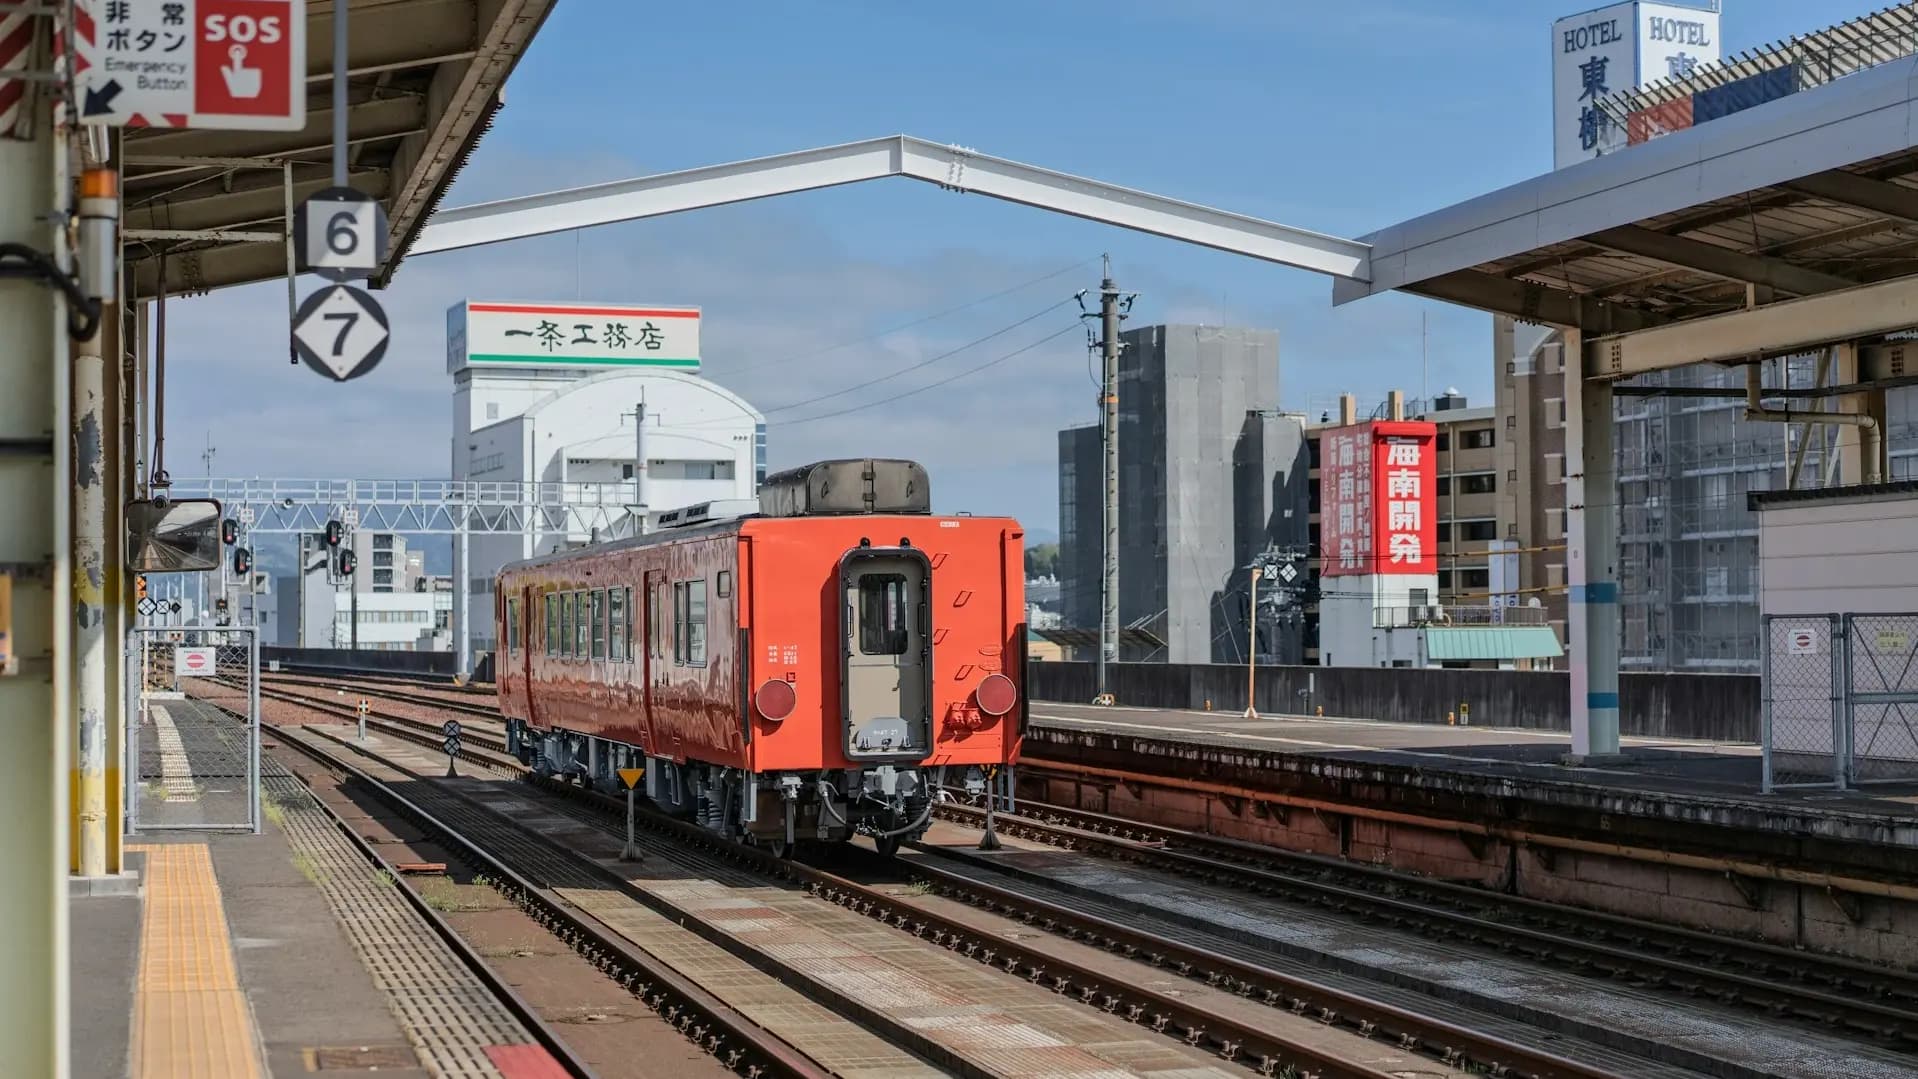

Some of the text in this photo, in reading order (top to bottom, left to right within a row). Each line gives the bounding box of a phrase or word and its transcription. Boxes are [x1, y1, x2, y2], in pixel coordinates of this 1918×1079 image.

[105, 1, 186, 26] 非常
[204, 14, 282, 44] SOS
[106, 29, 187, 53] ボタン
[1564, 19, 1622, 53] HOTEL
[1649, 16, 1711, 47] HOTEL
[104, 57, 188, 76] Emergency
[137, 75, 187, 91] Button
[325, 211, 359, 256] 6
[323, 312, 360, 357] 7
[504, 320, 665, 352] 一条工務店
[1339, 435, 1355, 569] 海南開発
[1386, 437, 1422, 565] 海南開発
